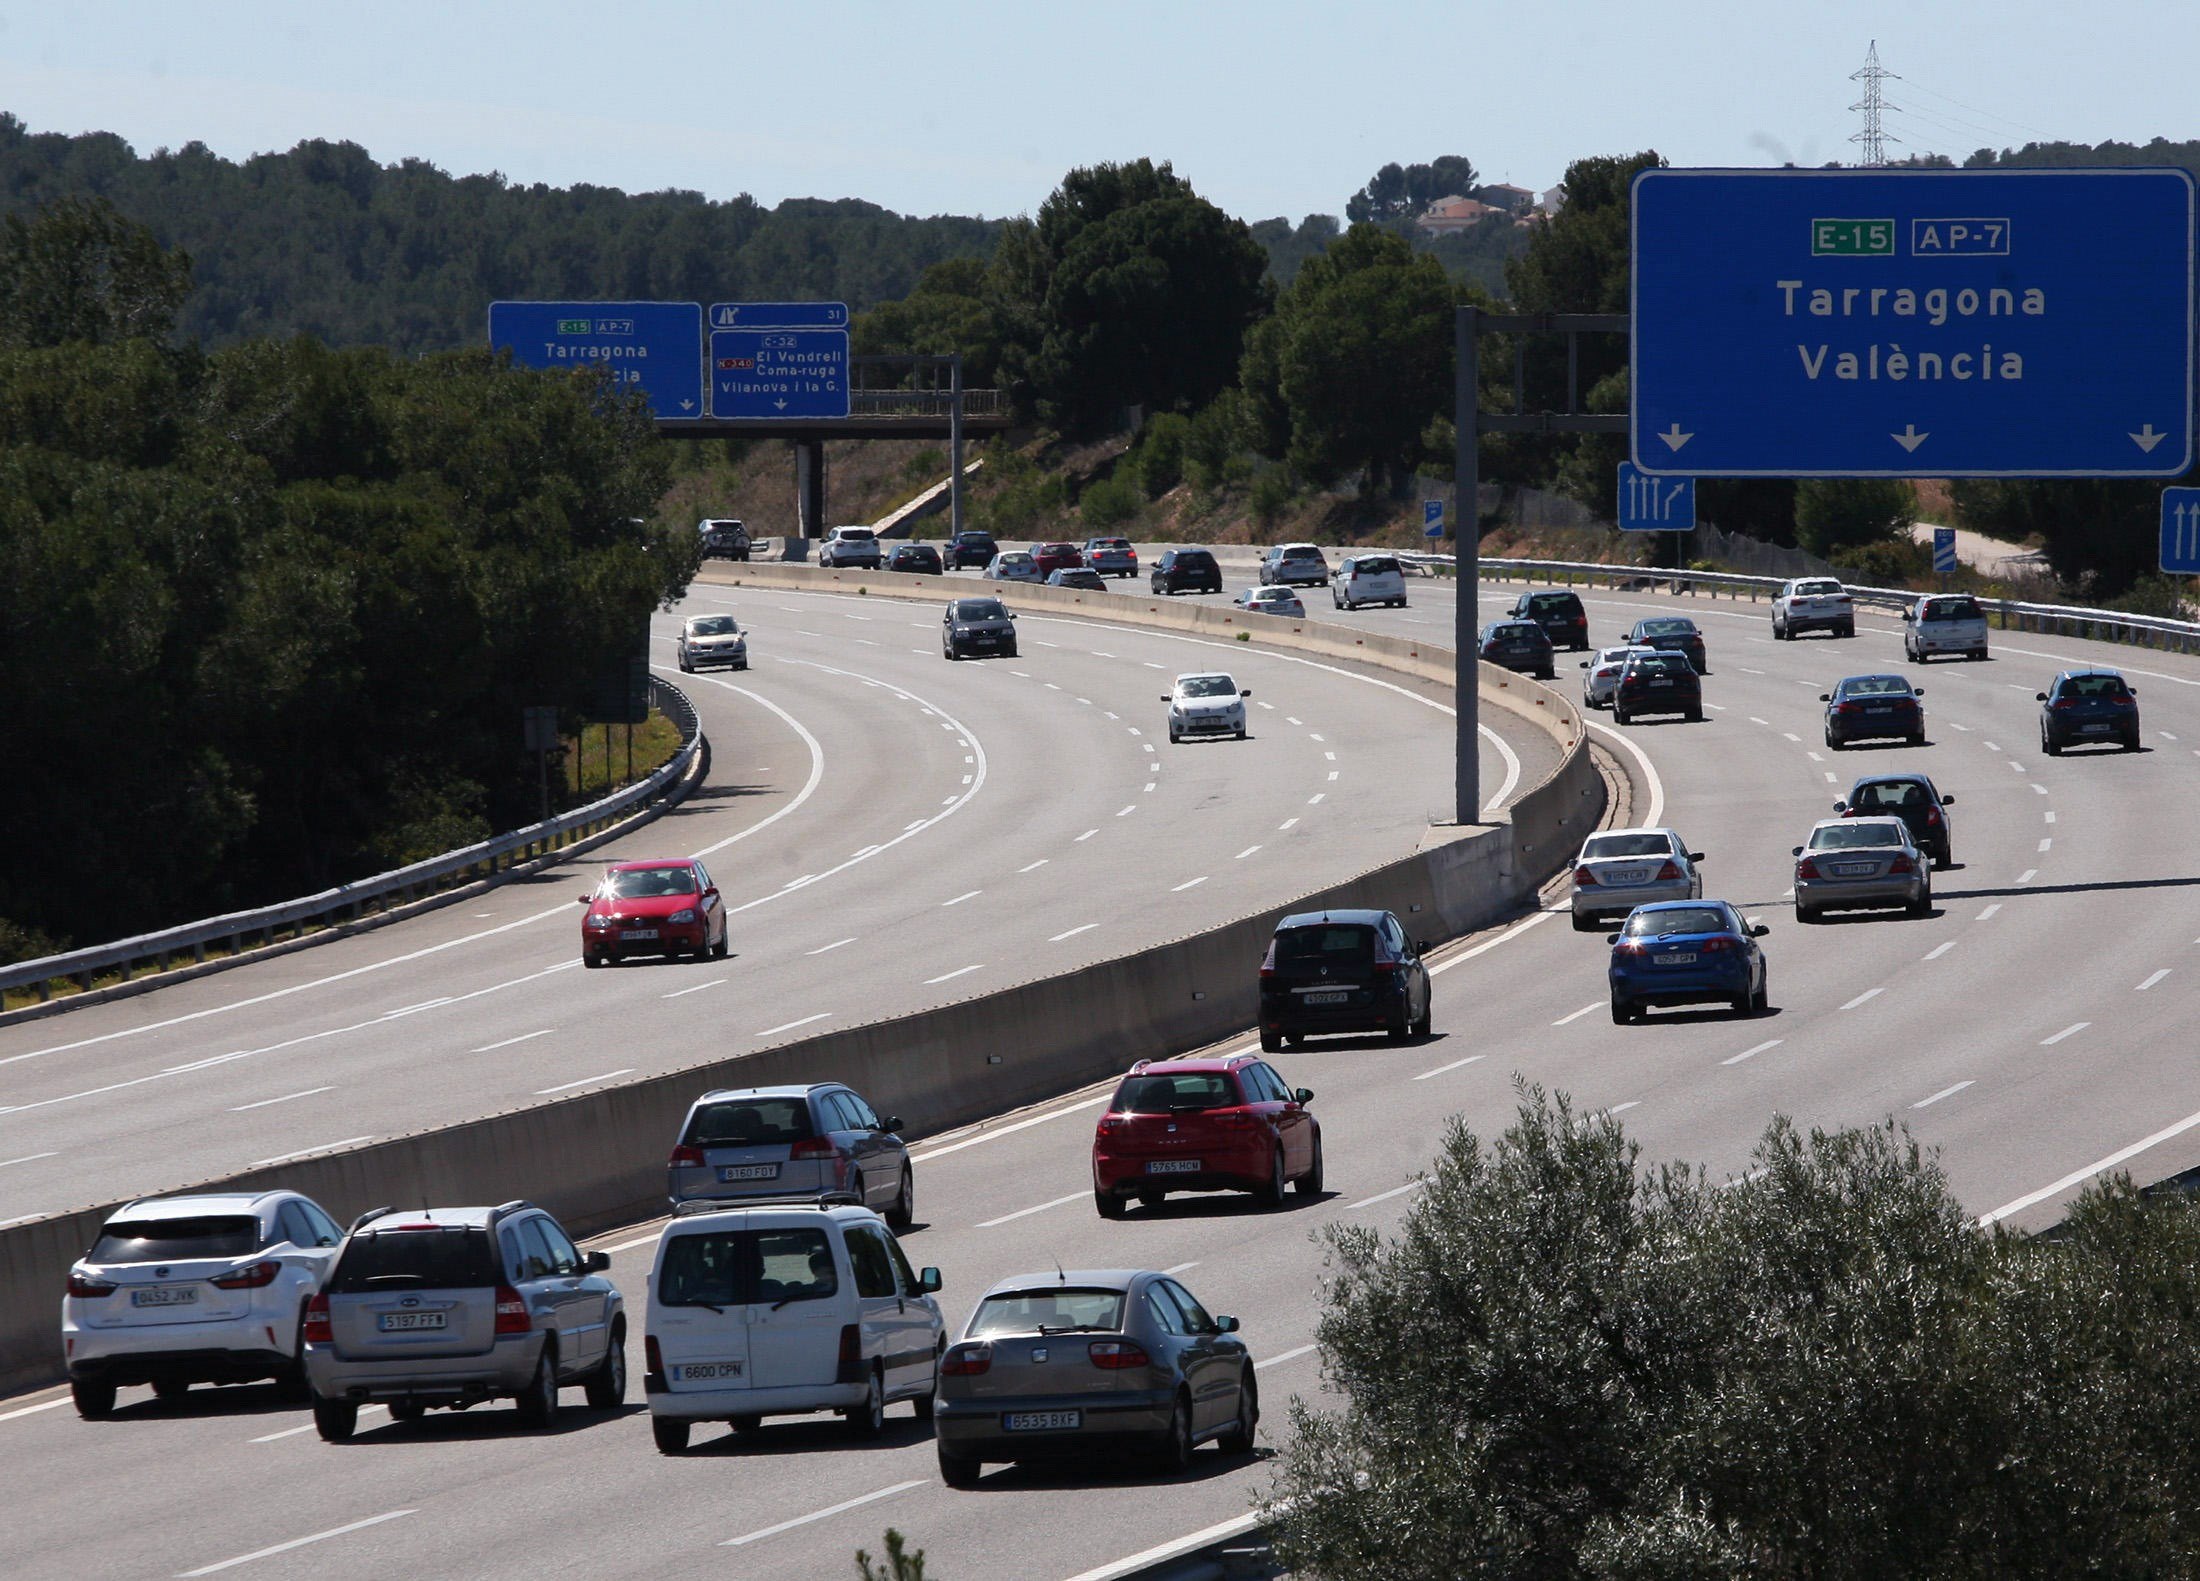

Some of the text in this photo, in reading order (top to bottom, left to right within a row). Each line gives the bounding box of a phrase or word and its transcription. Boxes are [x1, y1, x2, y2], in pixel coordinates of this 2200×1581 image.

[1818, 225, 1888, 250] E-15
[1919, 224, 2004, 249] AP-7
[1776, 280, 2046, 326] Tarragona
[828, 310, 840, 320] 31
[559, 321, 588, 332] E-15
[598, 321, 631, 332] AP-7
[545, 342, 648, 361] Tarragona
[756, 351, 841, 362] El Vendrell
[1797, 343, 2024, 381] València
[756, 364, 836, 378] Coma-ruga
[721, 382, 788, 393] Vilanova
[727, 1168, 752, 1179] 8160
[1152, 1161, 1177, 1172] 5765
[686, 1364, 741, 1379] 6600 CPN
[1013, 1412, 1075, 1428] 6535 BXF
